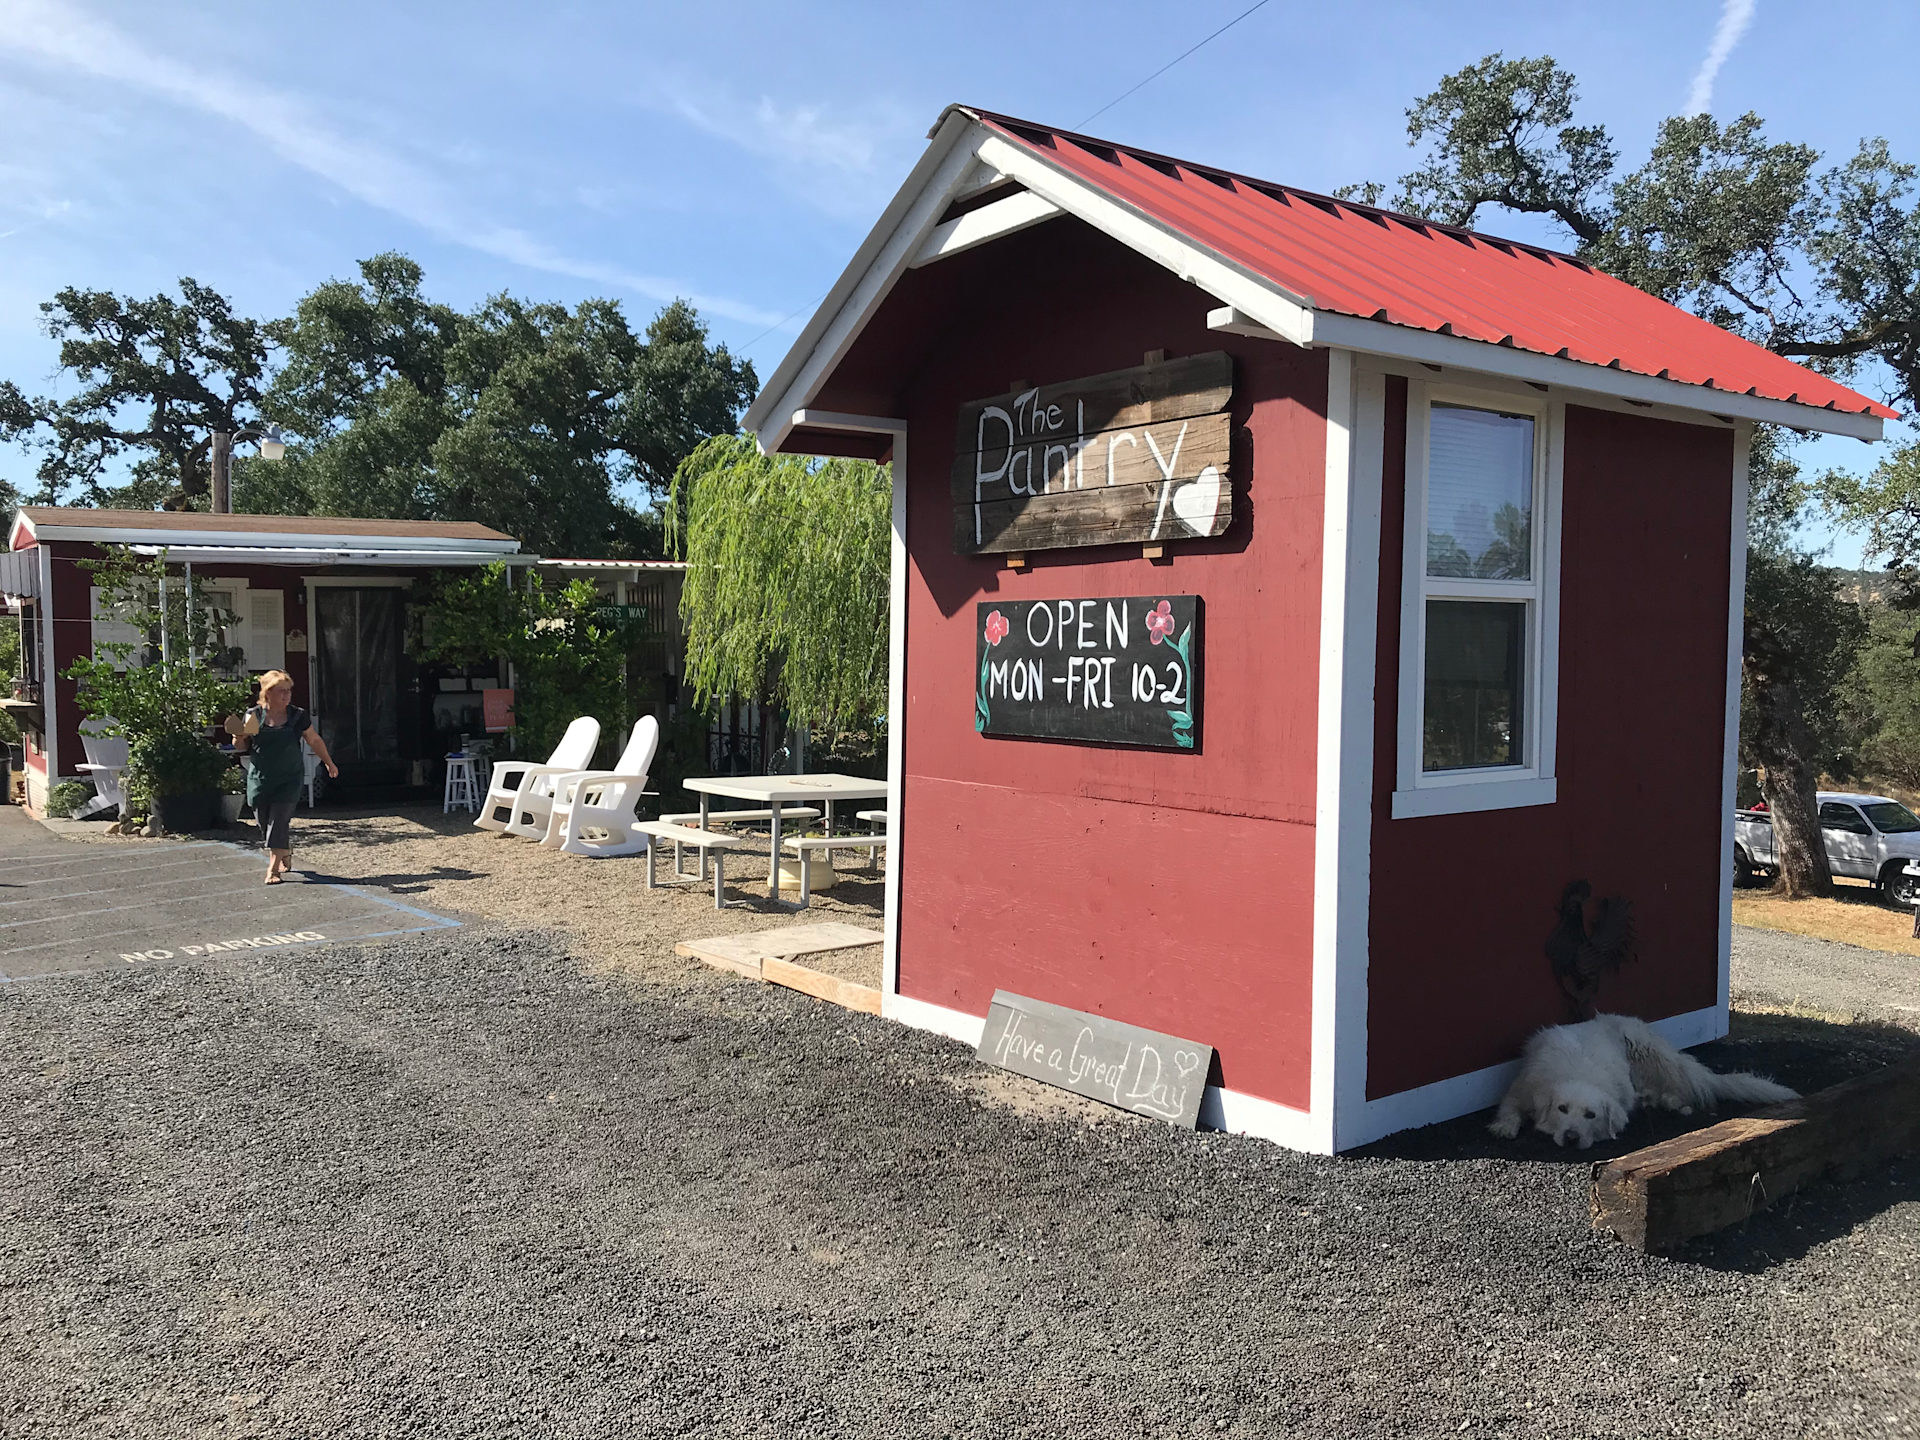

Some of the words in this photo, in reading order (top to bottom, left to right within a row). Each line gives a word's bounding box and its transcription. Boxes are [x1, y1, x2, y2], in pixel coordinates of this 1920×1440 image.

[1013, 387, 1065, 436] The
[974, 398, 1188, 545] Pantry
[628, 607, 647, 619] WAY
[1026, 599, 1129, 651] OPEN
[989, 657, 1044, 702] MON
[1131, 660, 1187, 705] 10-2
[117, 949, 175, 964] NO
[178, 930, 327, 956] PARKING
[994, 1008, 1045, 1067] Have
[1047, 1048, 1064, 1071] a
[1067, 1026, 1134, 1105] Great
[1125, 1043, 1187, 1119] Day
